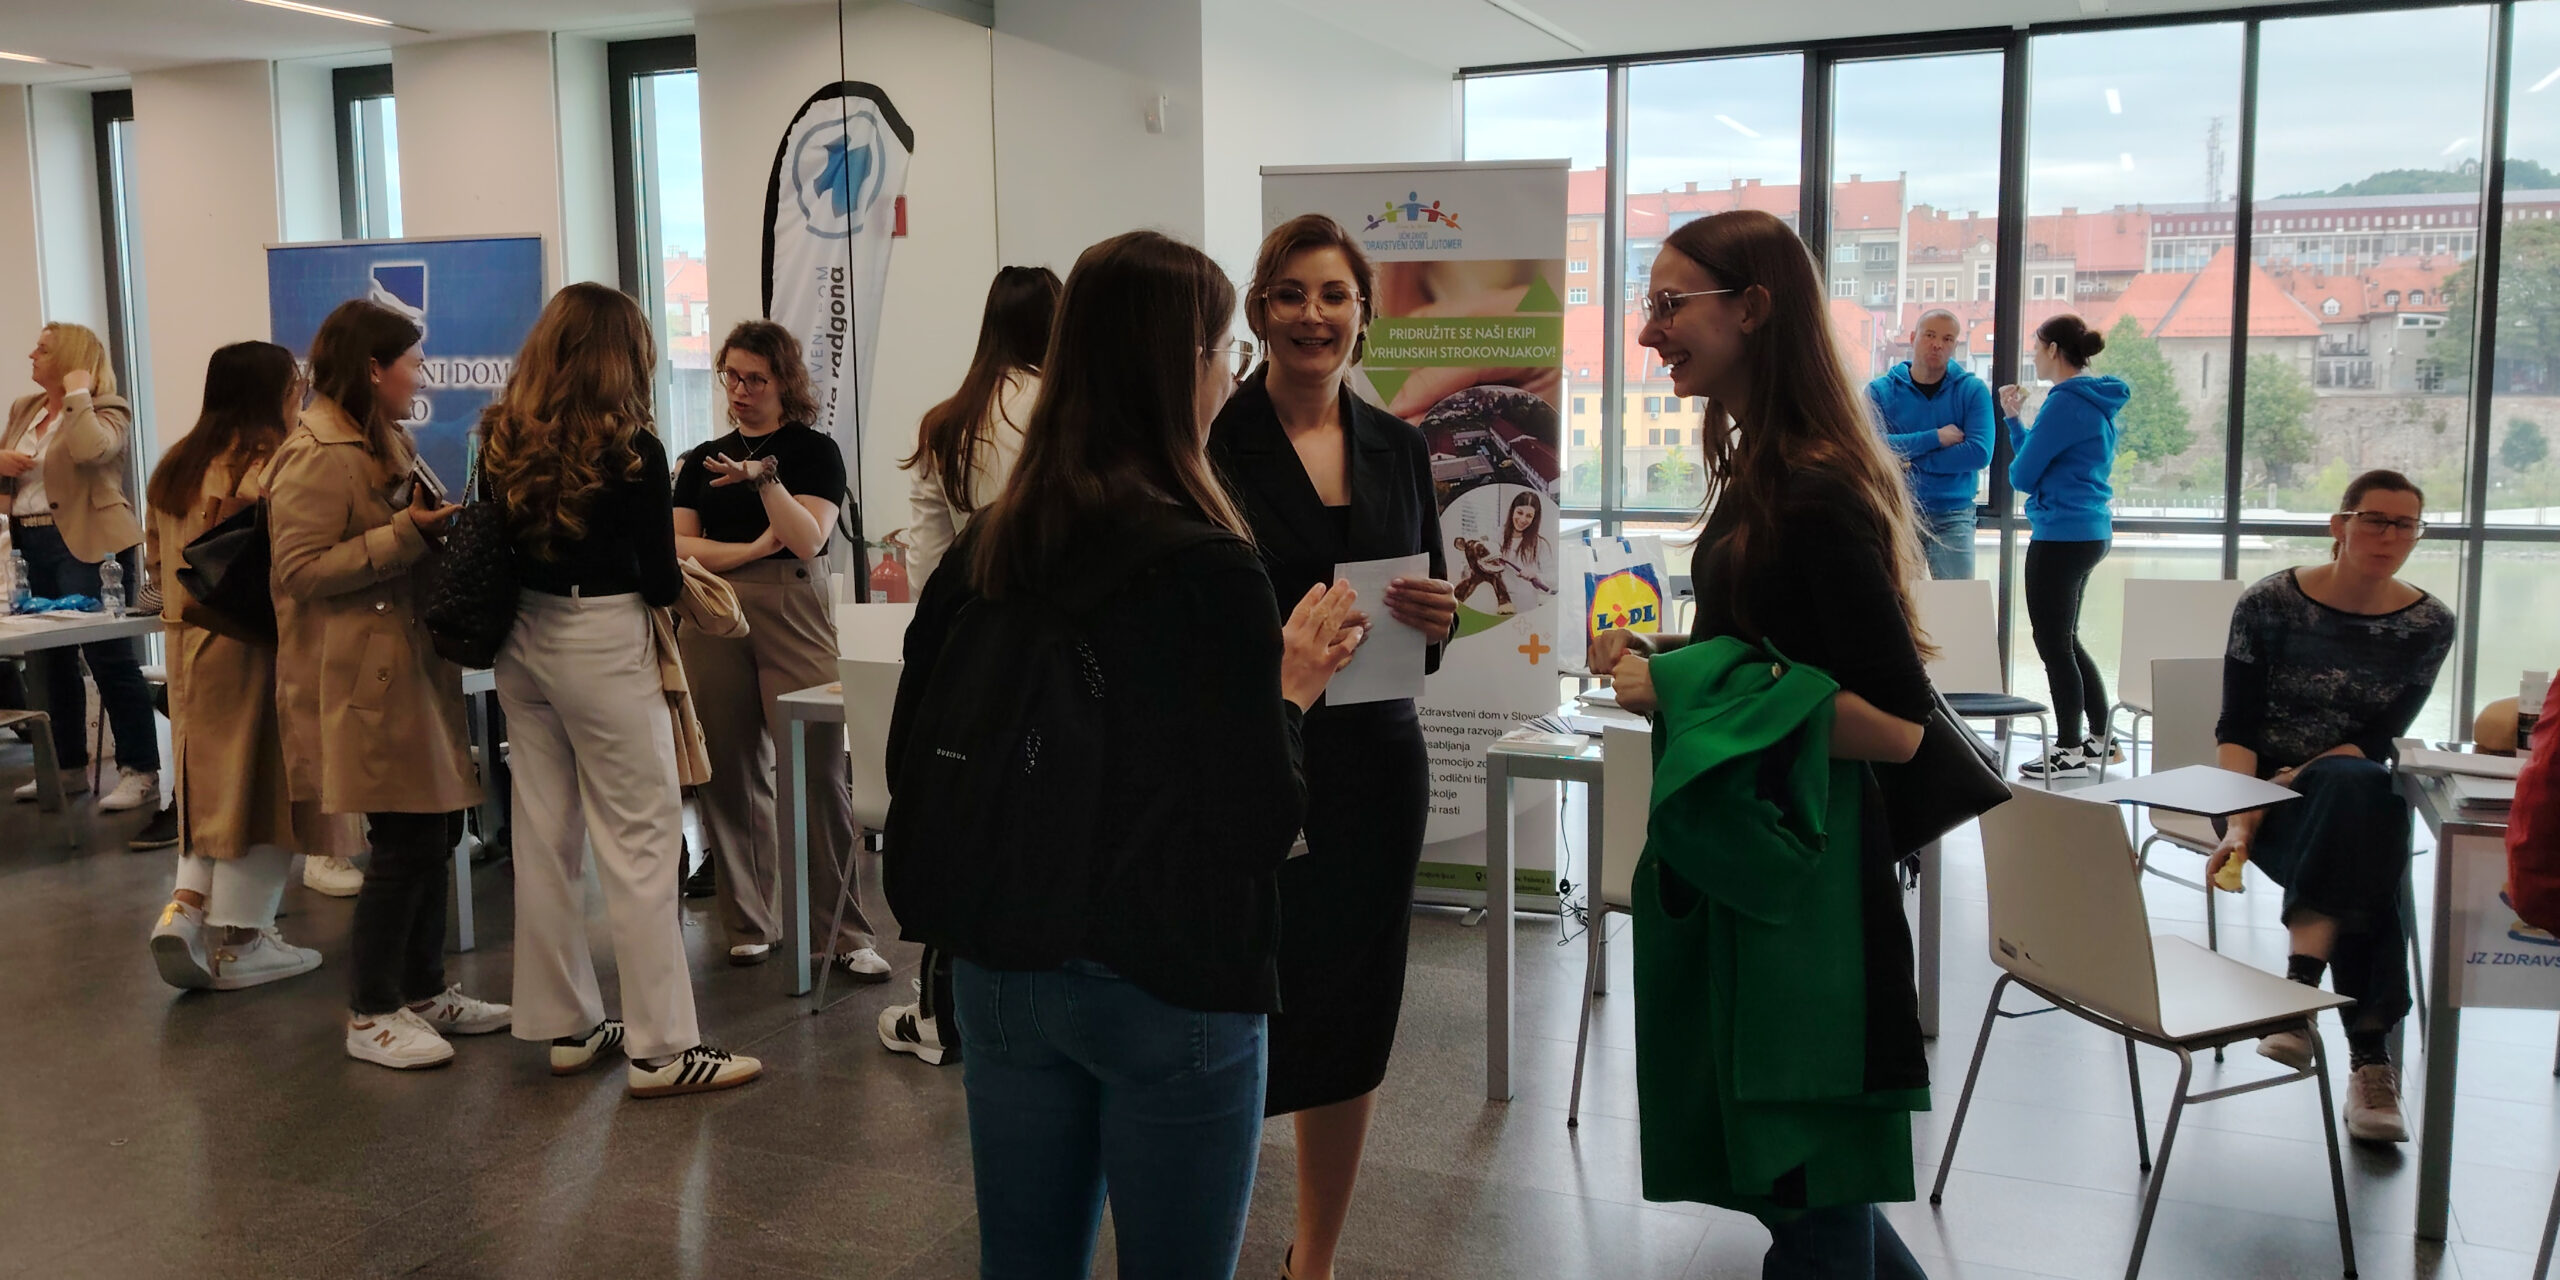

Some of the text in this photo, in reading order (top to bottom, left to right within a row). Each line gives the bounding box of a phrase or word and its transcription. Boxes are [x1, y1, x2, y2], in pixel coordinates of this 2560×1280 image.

[1409, 240, 1425, 250] DOM
[1426, 239, 1462, 250] LJUTOMER
[827, 267, 848, 379] radgona
[1389, 325, 1536, 340] PRIDRUŽITE SE NAŠI EKIPI
[1370, 346, 1556, 359] VRHUNSKIH STROKOVNJAKOV!
[454, 362, 511, 385] DOM
[1419, 707, 1476, 718] Zdravstveni
[1479, 711, 1500, 720] dom
[1421, 724, 1503, 737] kovnega razvoja
[1439, 773, 1472, 783] odlični
[1439, 807, 1460, 815] rasti
[2466, 952, 2488, 964] JZ
